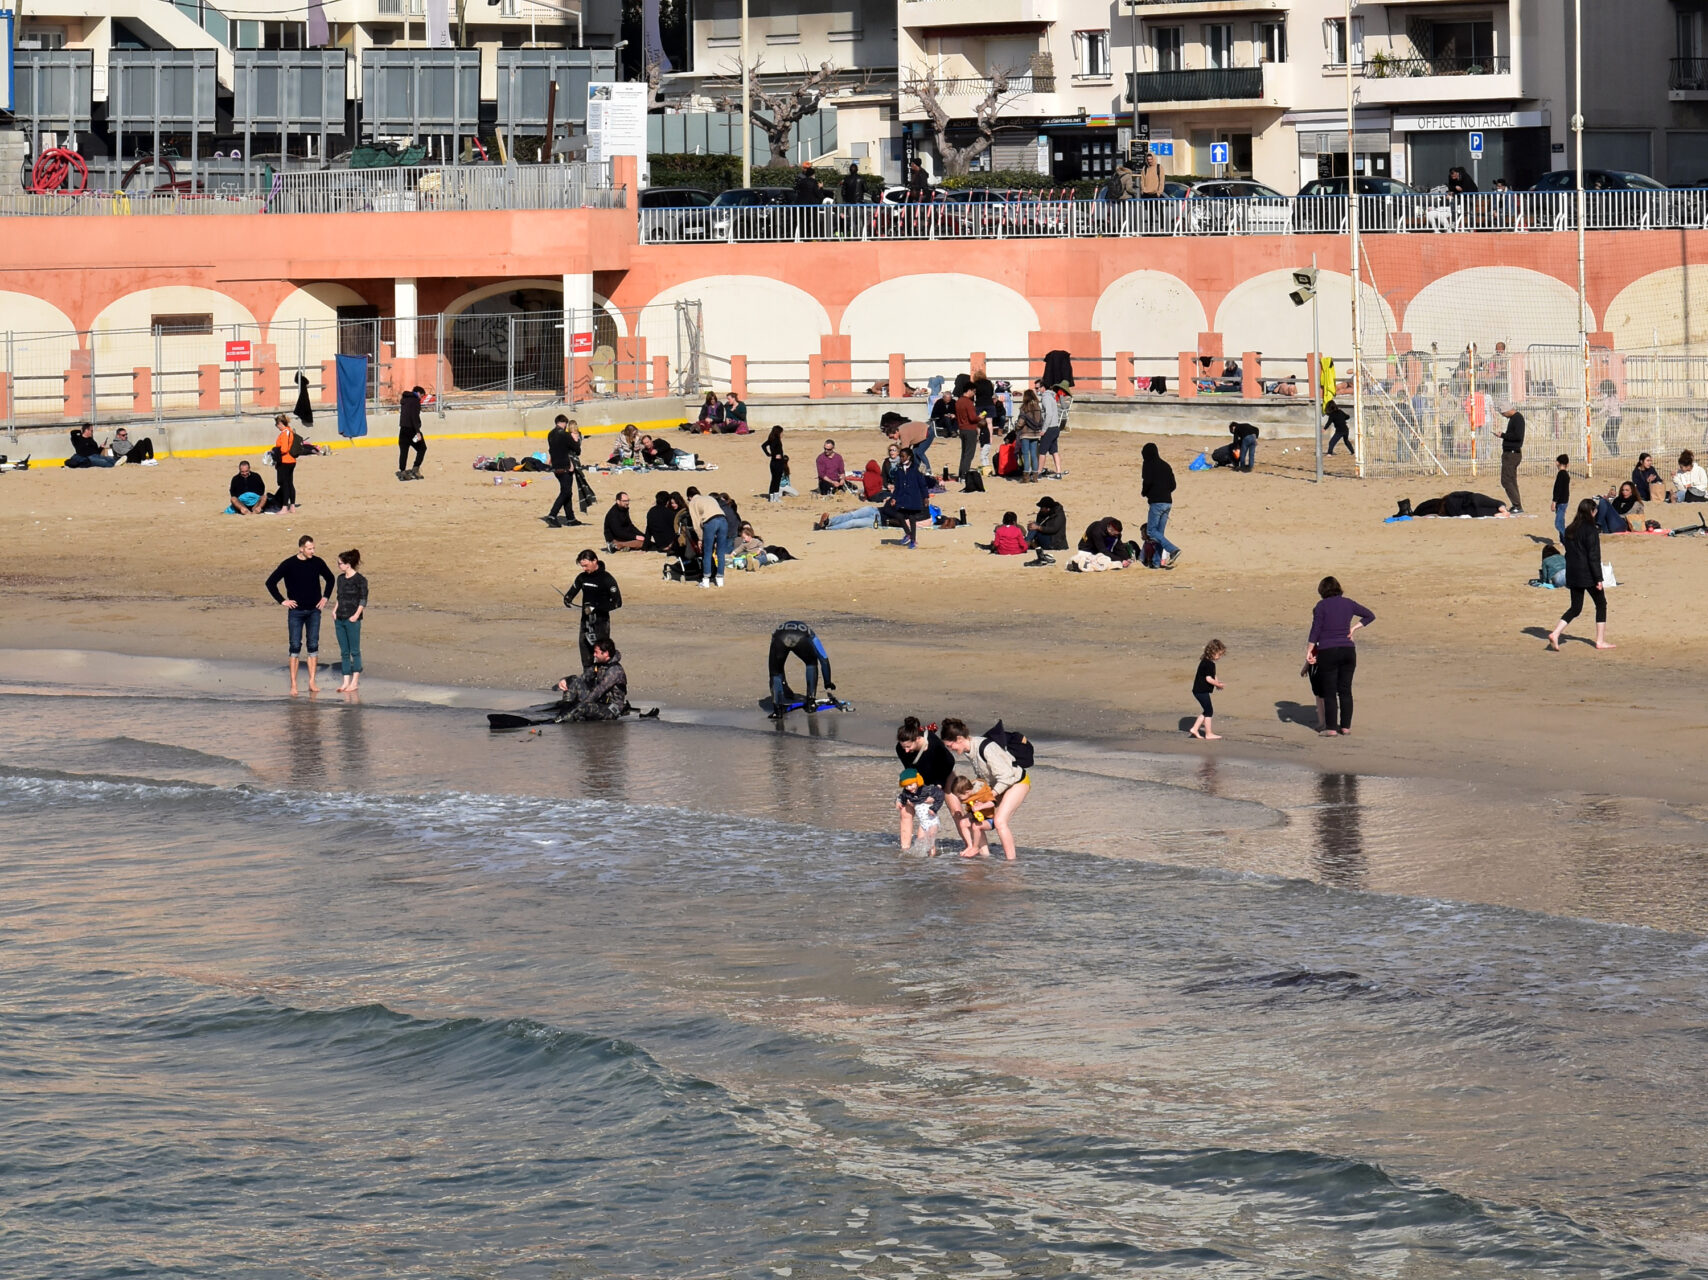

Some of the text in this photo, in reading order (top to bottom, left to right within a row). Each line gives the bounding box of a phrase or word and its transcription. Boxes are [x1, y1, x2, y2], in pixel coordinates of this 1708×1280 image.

[1418, 113, 1514, 129] OFFICE NOTARIAL
[1473, 135, 1480, 148] P
